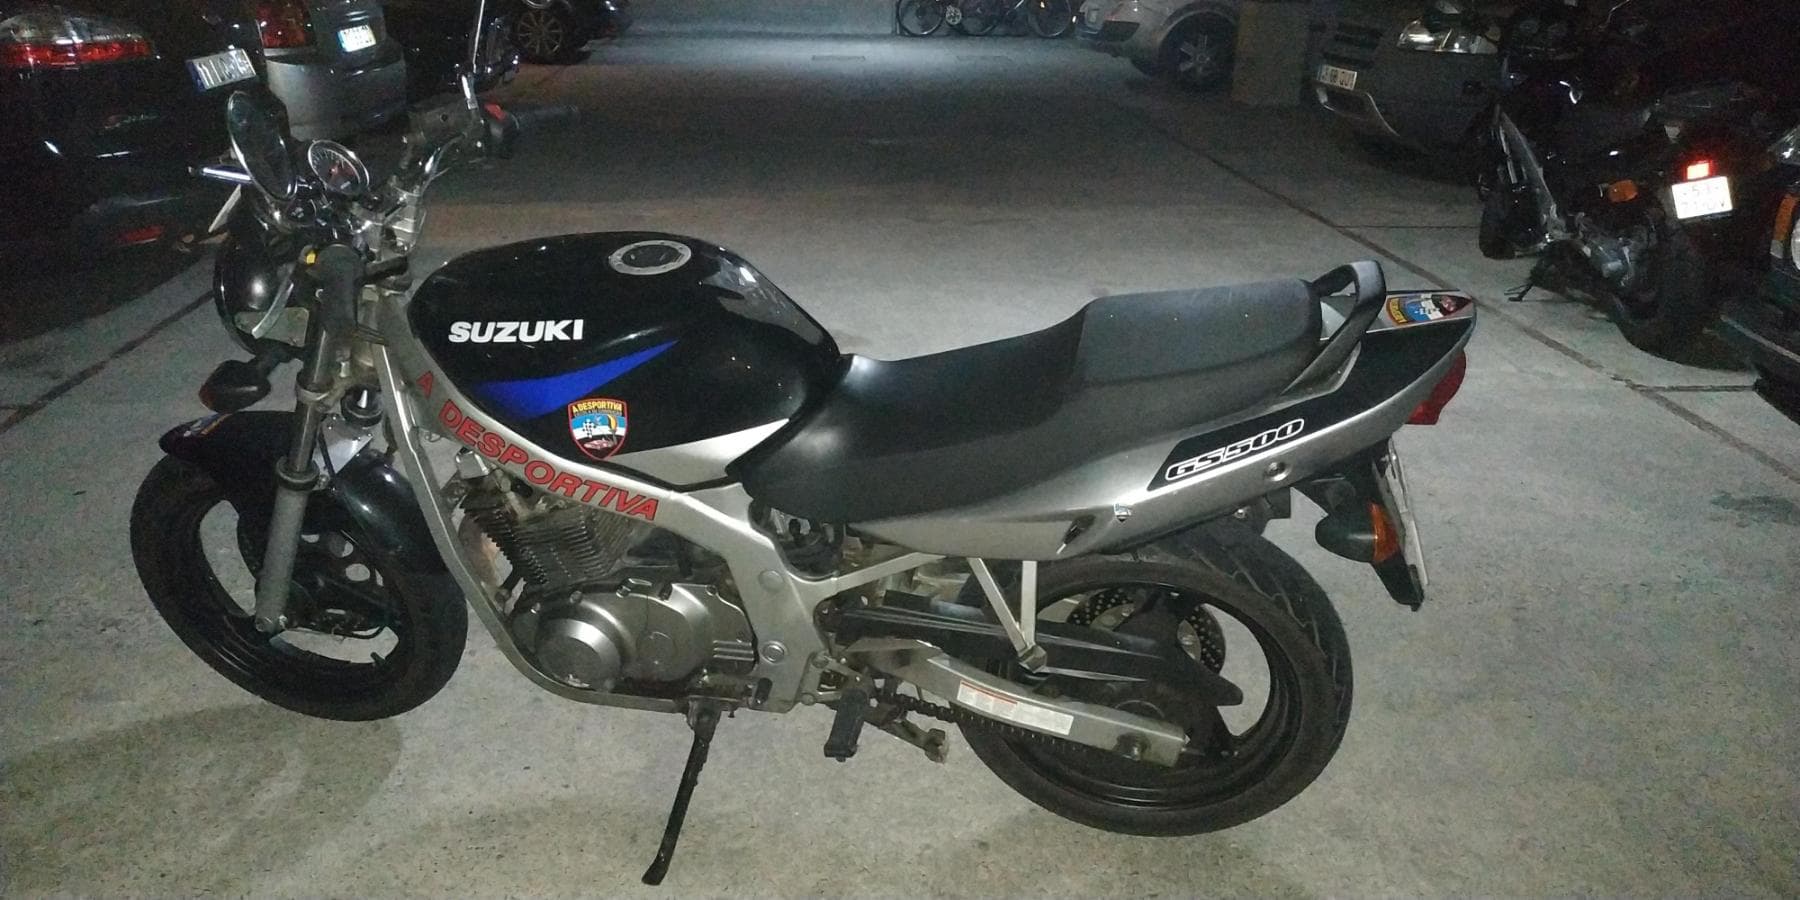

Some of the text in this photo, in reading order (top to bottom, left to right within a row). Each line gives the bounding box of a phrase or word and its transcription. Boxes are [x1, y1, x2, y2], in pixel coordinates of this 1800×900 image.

[448, 319, 584, 343] SUZUKI
[577, 400, 622, 412] DESPORTIVA
[417, 370, 659, 521] A DESPORTIVA
[1165, 418, 1304, 481] GS500
